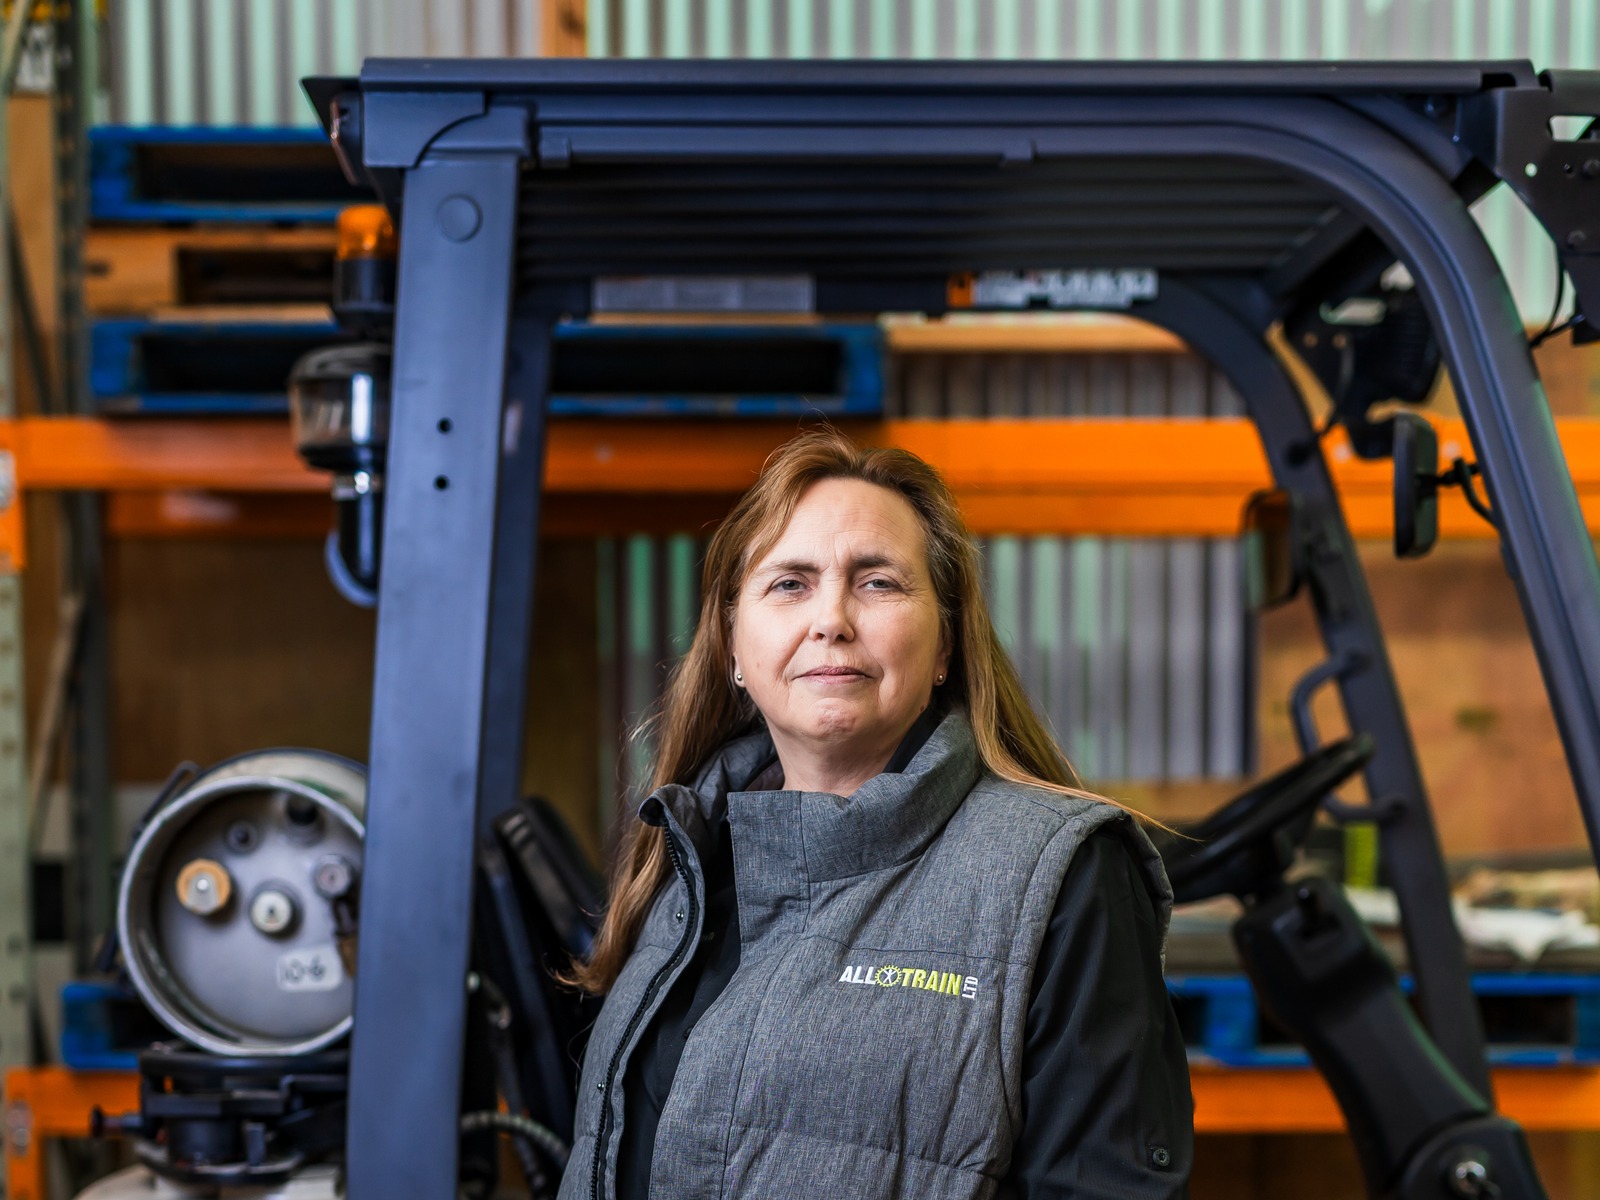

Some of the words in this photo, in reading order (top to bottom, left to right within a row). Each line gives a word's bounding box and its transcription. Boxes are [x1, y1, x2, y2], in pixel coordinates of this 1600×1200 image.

[839, 965, 876, 985] ALL
[902, 967, 962, 996] TRAIN
[961, 975, 979, 999] LTD
